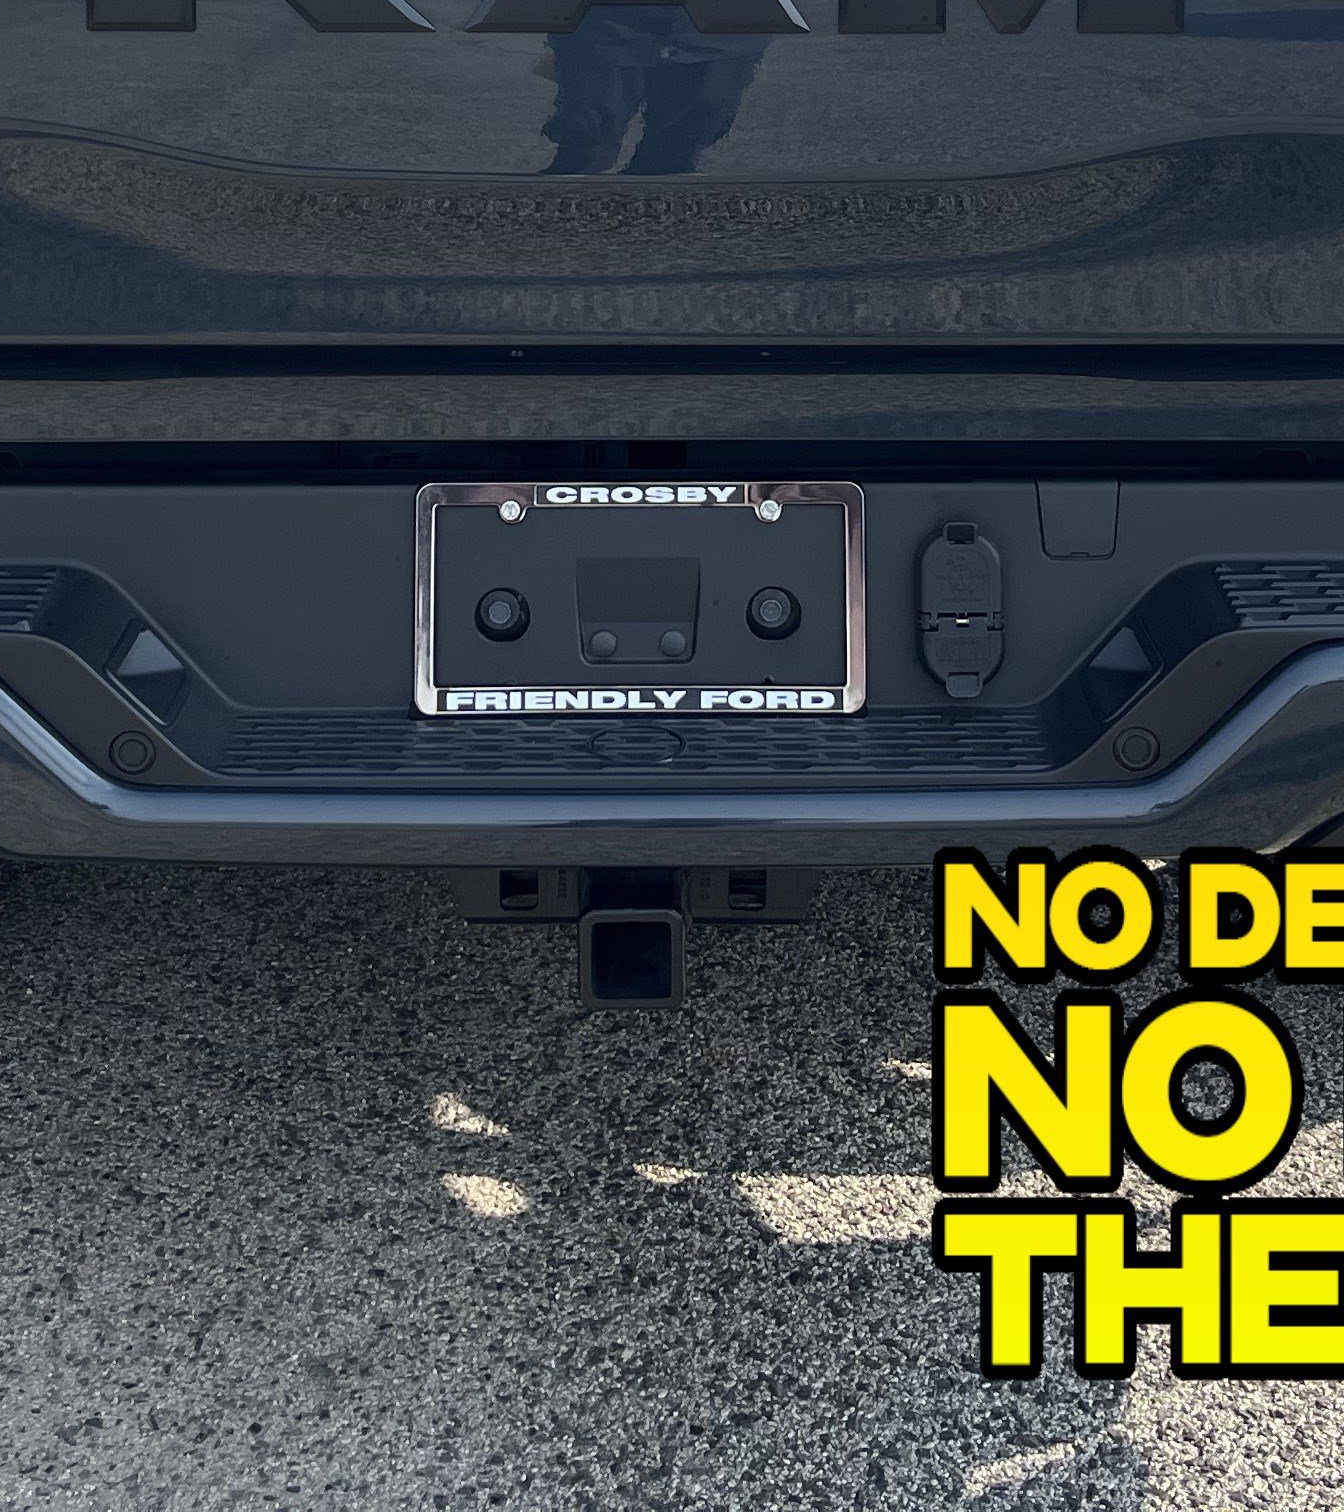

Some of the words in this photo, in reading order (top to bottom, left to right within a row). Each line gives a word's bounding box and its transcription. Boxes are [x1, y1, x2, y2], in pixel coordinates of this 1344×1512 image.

[545, 486, 738, 504] CROSBY
[445, 690, 687, 711] FRIENDLY
[699, 690, 837, 711] FORD
